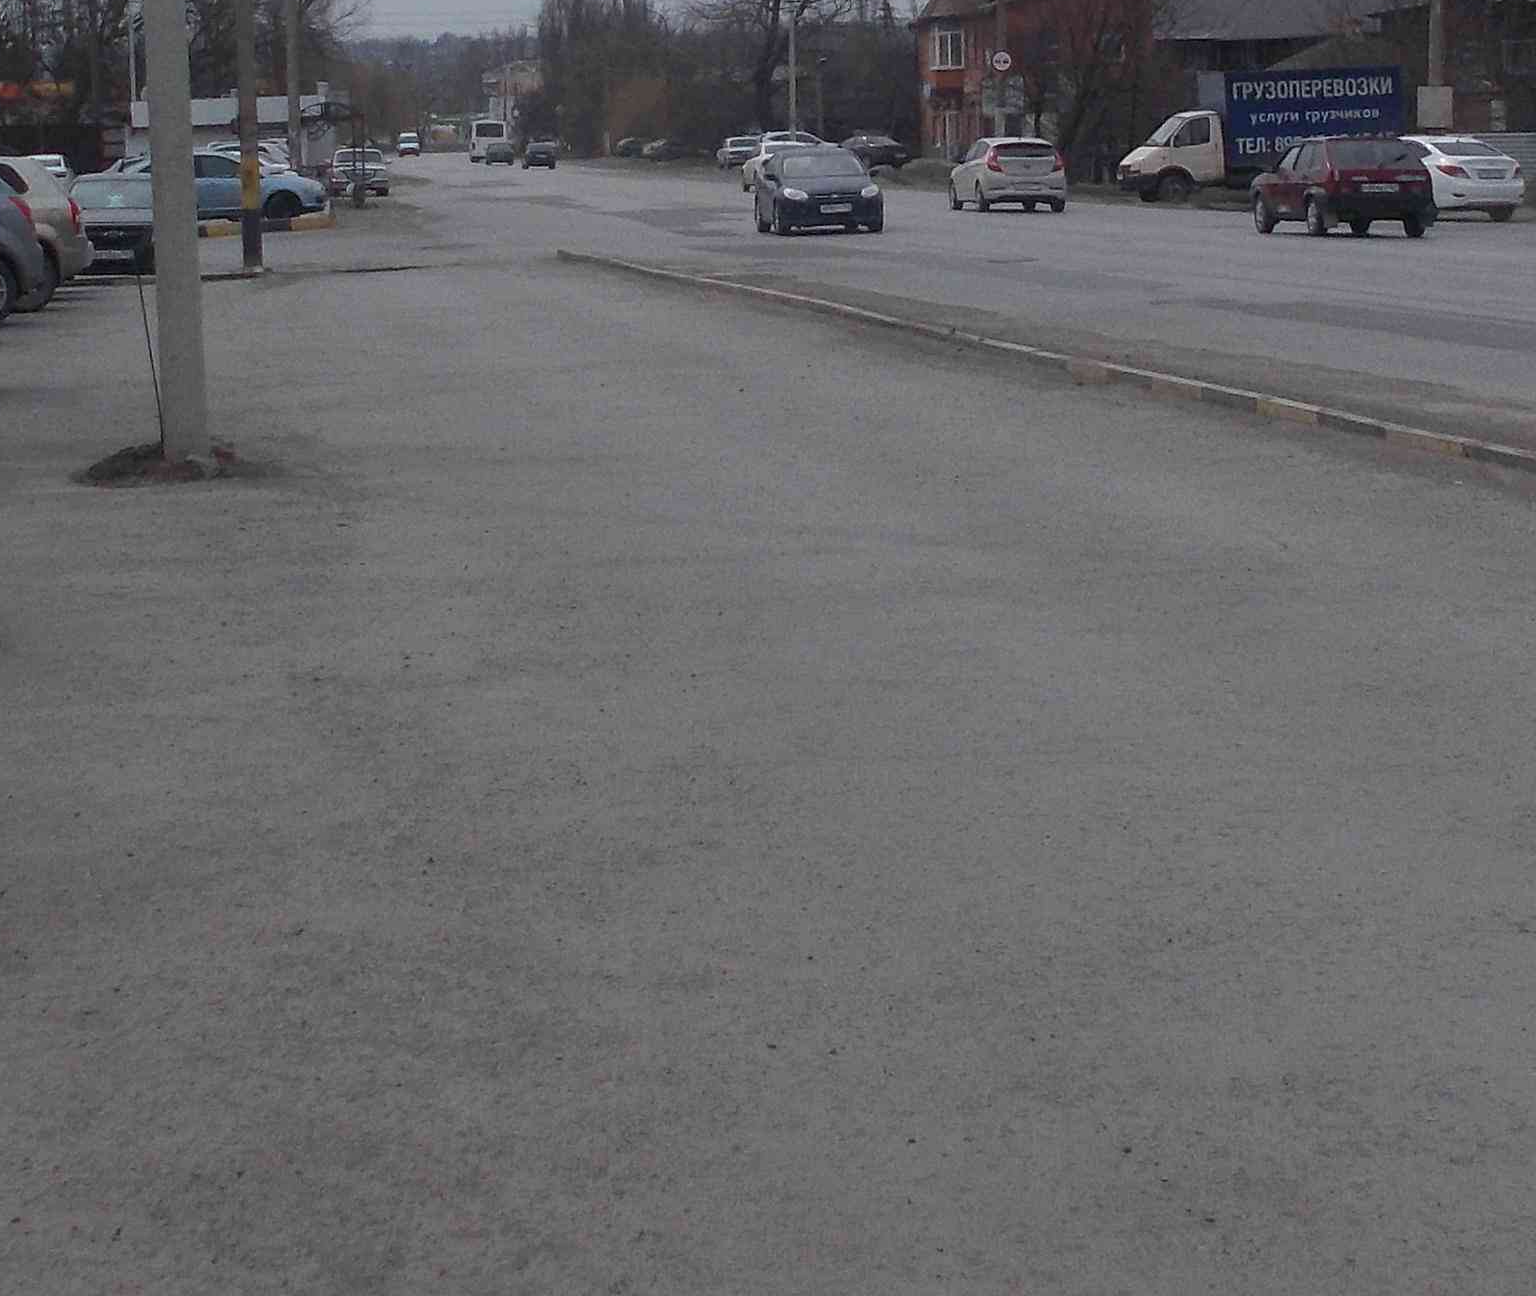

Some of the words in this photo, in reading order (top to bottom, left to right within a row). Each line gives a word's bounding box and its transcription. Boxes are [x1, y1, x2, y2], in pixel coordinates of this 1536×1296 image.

[1232, 76, 1393, 101] ГРУЗОПЕРЕВОЗКИ
[1249, 111, 1300, 126] услуги
[1305, 108, 1380, 124] грузчиков
[1235, 136, 1271, 154] ТЕЛ:
